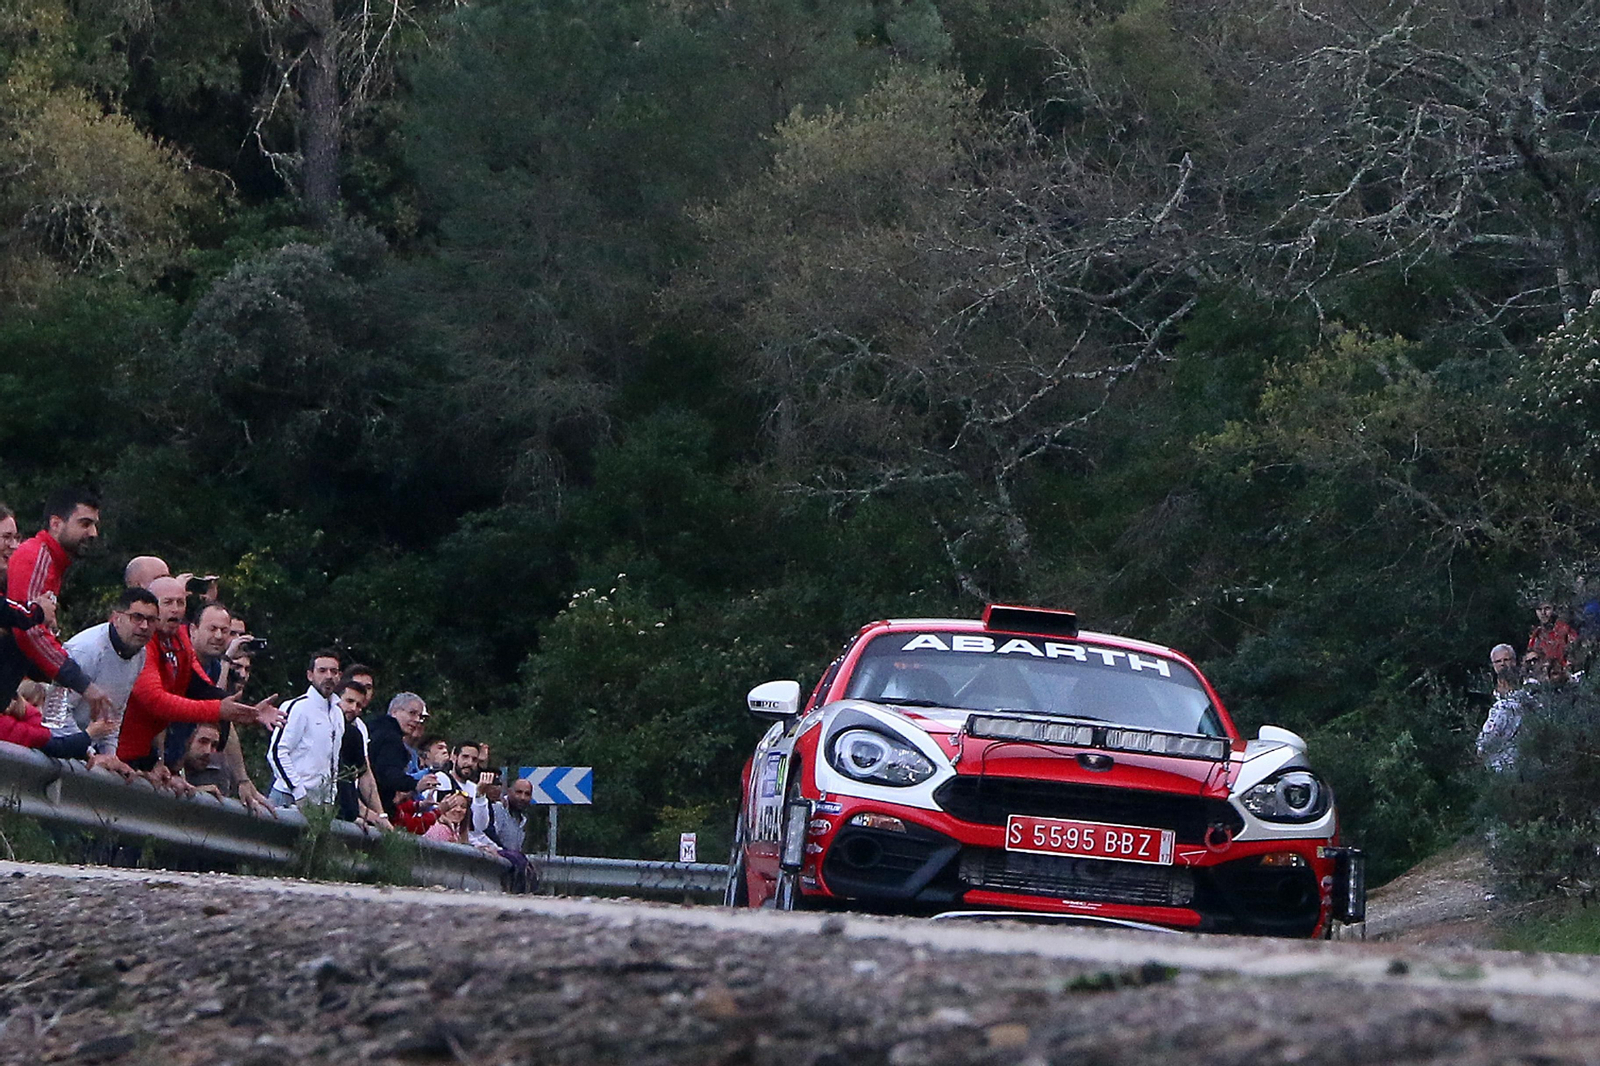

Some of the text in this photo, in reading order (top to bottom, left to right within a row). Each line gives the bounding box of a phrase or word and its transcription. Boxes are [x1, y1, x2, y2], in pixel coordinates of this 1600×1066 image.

[901, 634, 1171, 678] ABARTH
[1010, 822, 1152, 856] S 5595 BBZ
